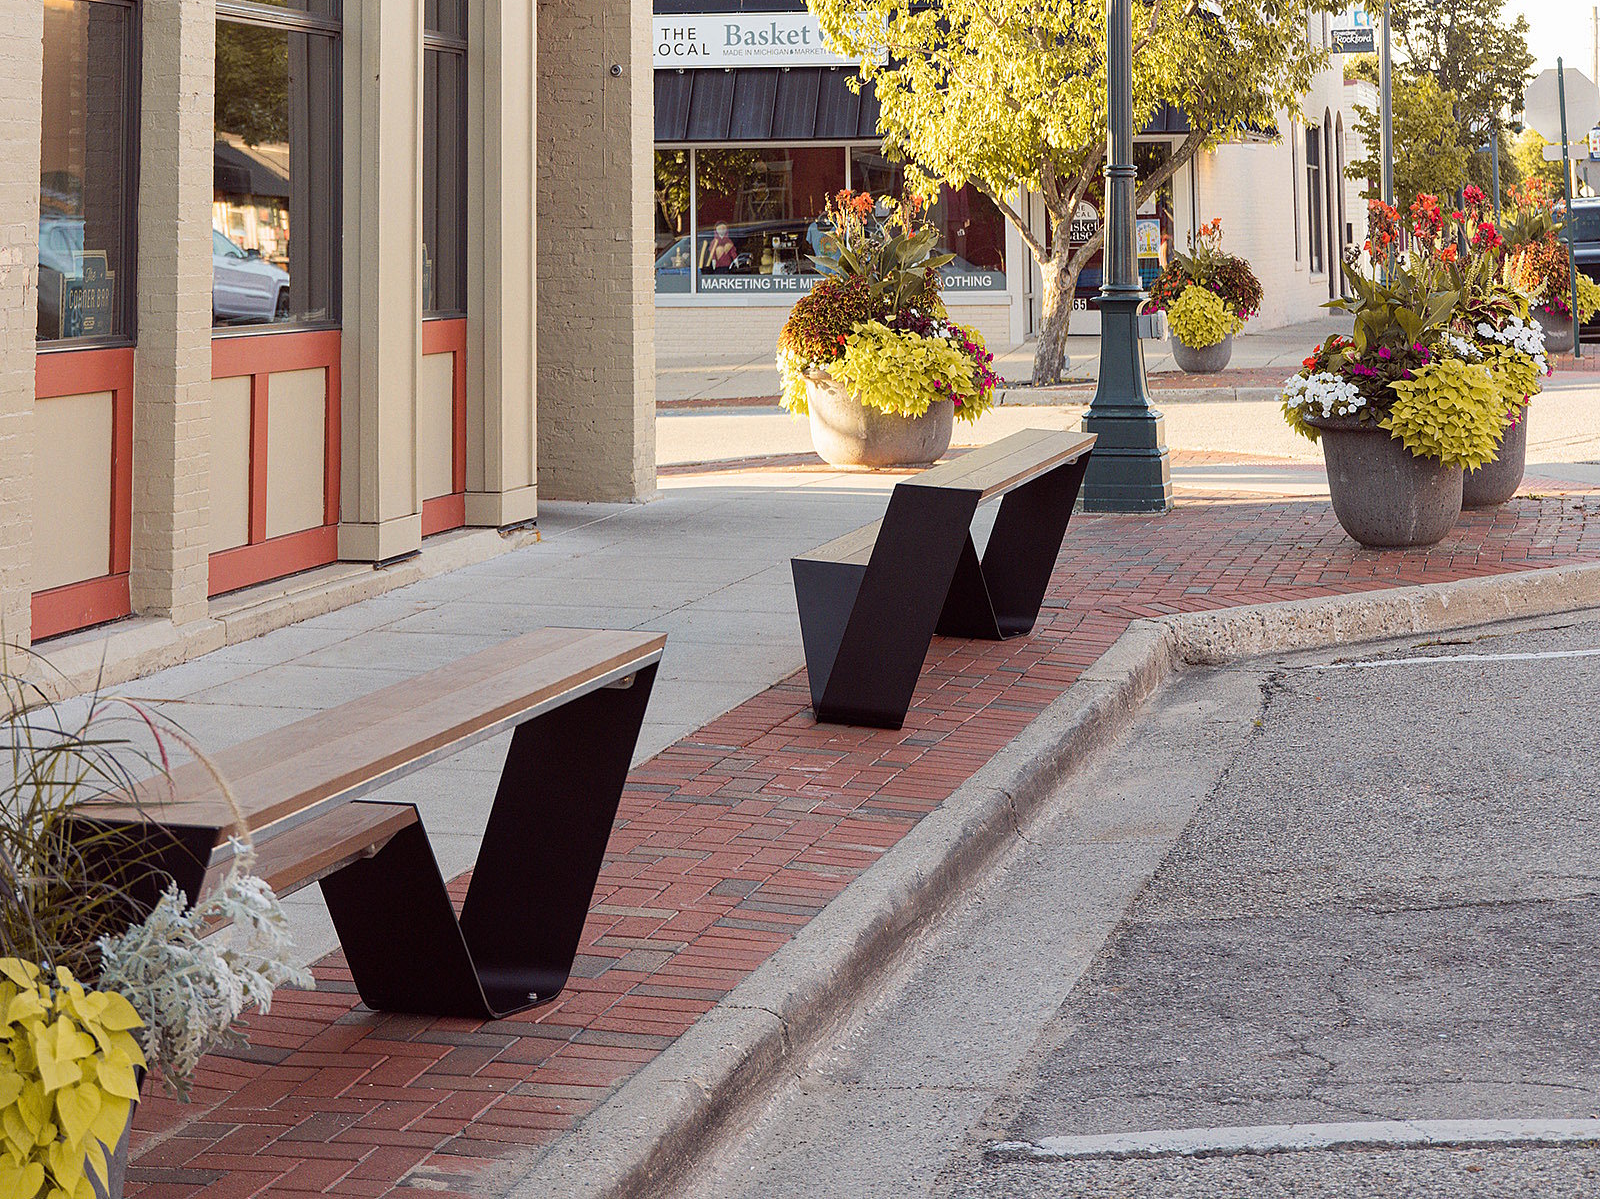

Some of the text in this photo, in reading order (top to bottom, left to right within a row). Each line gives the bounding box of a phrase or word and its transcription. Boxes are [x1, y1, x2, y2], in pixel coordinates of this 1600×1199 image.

[661, 28, 697, 41] THE
[723, 22, 810, 47] Basket
[654, 43, 710, 56] OCAL
[754, 48, 789, 56] MICHIGAN
[1070, 232, 1092, 241] ase
[701, 278, 770, 289] MARKETING
[773, 278, 797, 289] THE
[69, 289, 95, 309] CORNER
